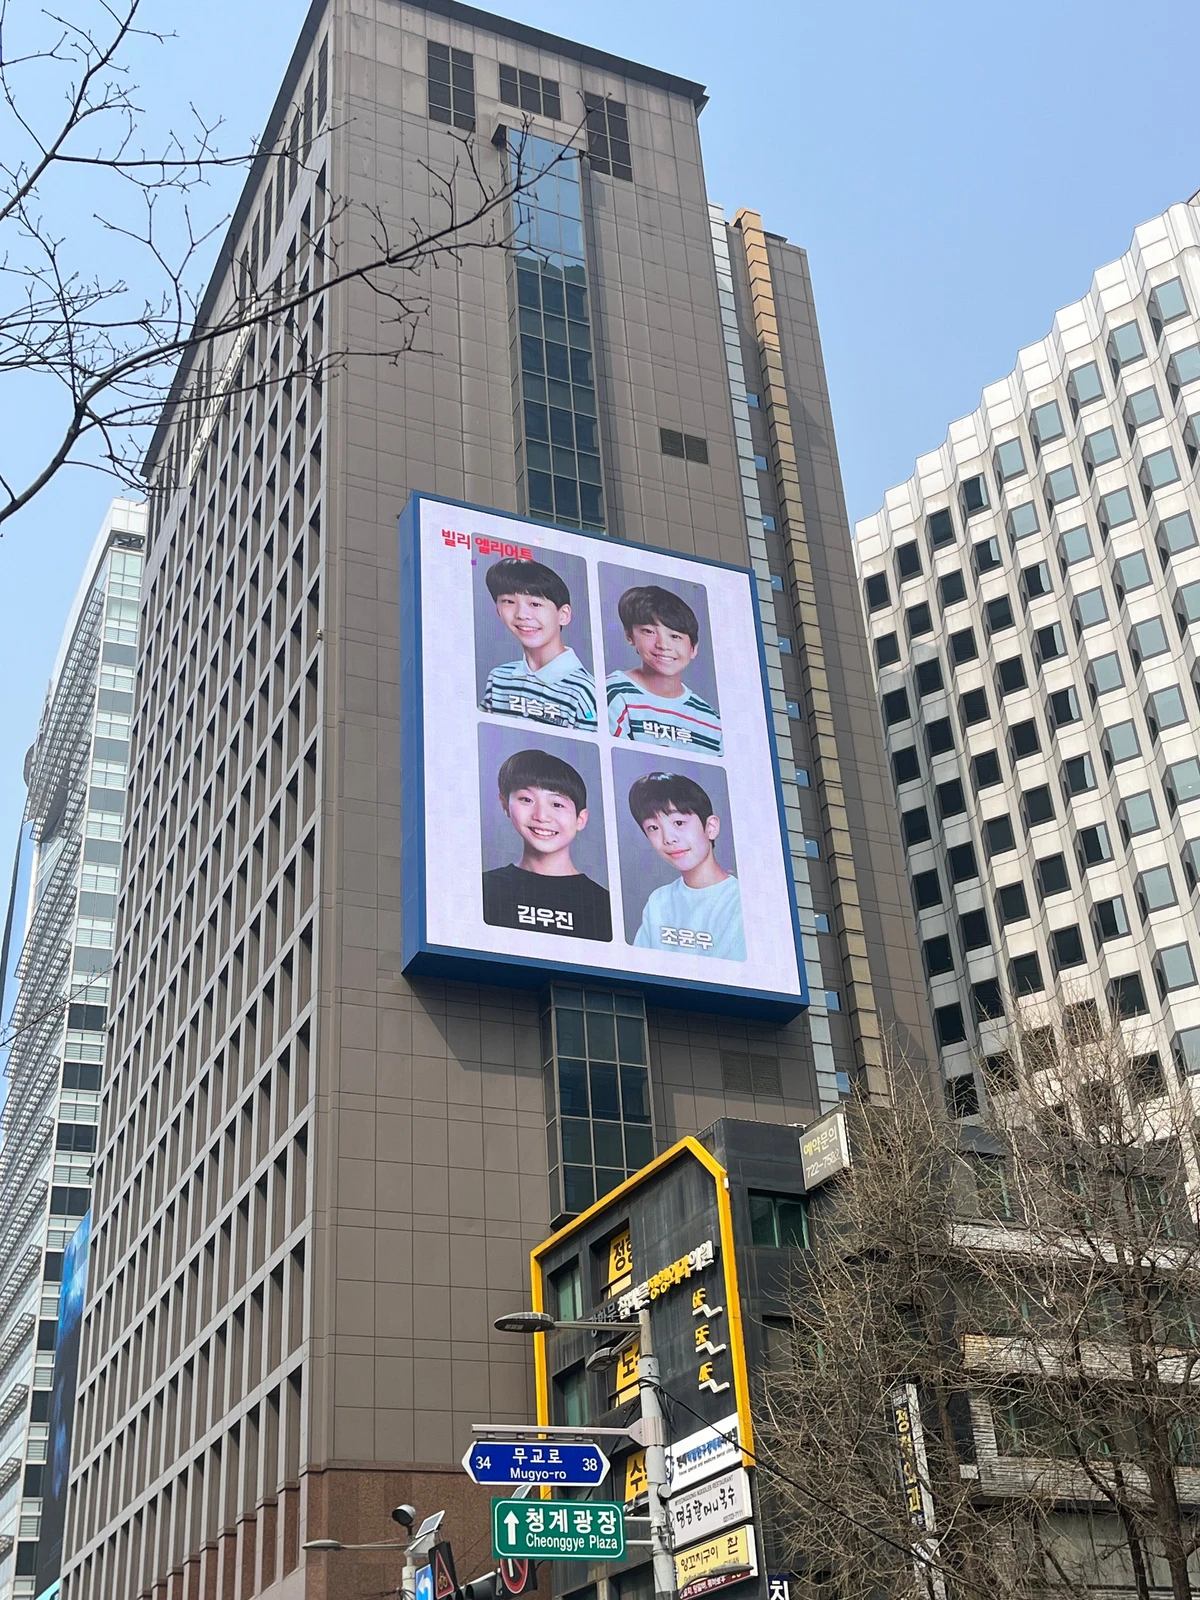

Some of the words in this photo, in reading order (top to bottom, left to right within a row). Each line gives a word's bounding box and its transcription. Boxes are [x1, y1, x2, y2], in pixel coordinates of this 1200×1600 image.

[441, 528, 471, 550] 빌리
[474, 536, 534, 562] 엘리어트
[508, 694, 562, 719] 김승주
[642, 720, 693, 744] 박지후
[517, 904, 574, 931] 김우진
[660, 926, 714, 950] 조윤우
[803, 1125, 838, 1157] 예약문의
[475, 1455, 492, 1470] 34
[512, 1447, 563, 1466] 무교로
[582, 1457, 598, 1472] 38
[510, 1467, 567, 1482] Mugyo-ro
[525, 1508, 617, 1535] 청계광장
[525, 1532, 585, 1551] Cheonggye
[589, 1534, 618, 1549] Plaza
[680, 1546, 719, 1572] 양꼬치구이
[769, 1580, 790, 1600] 치
